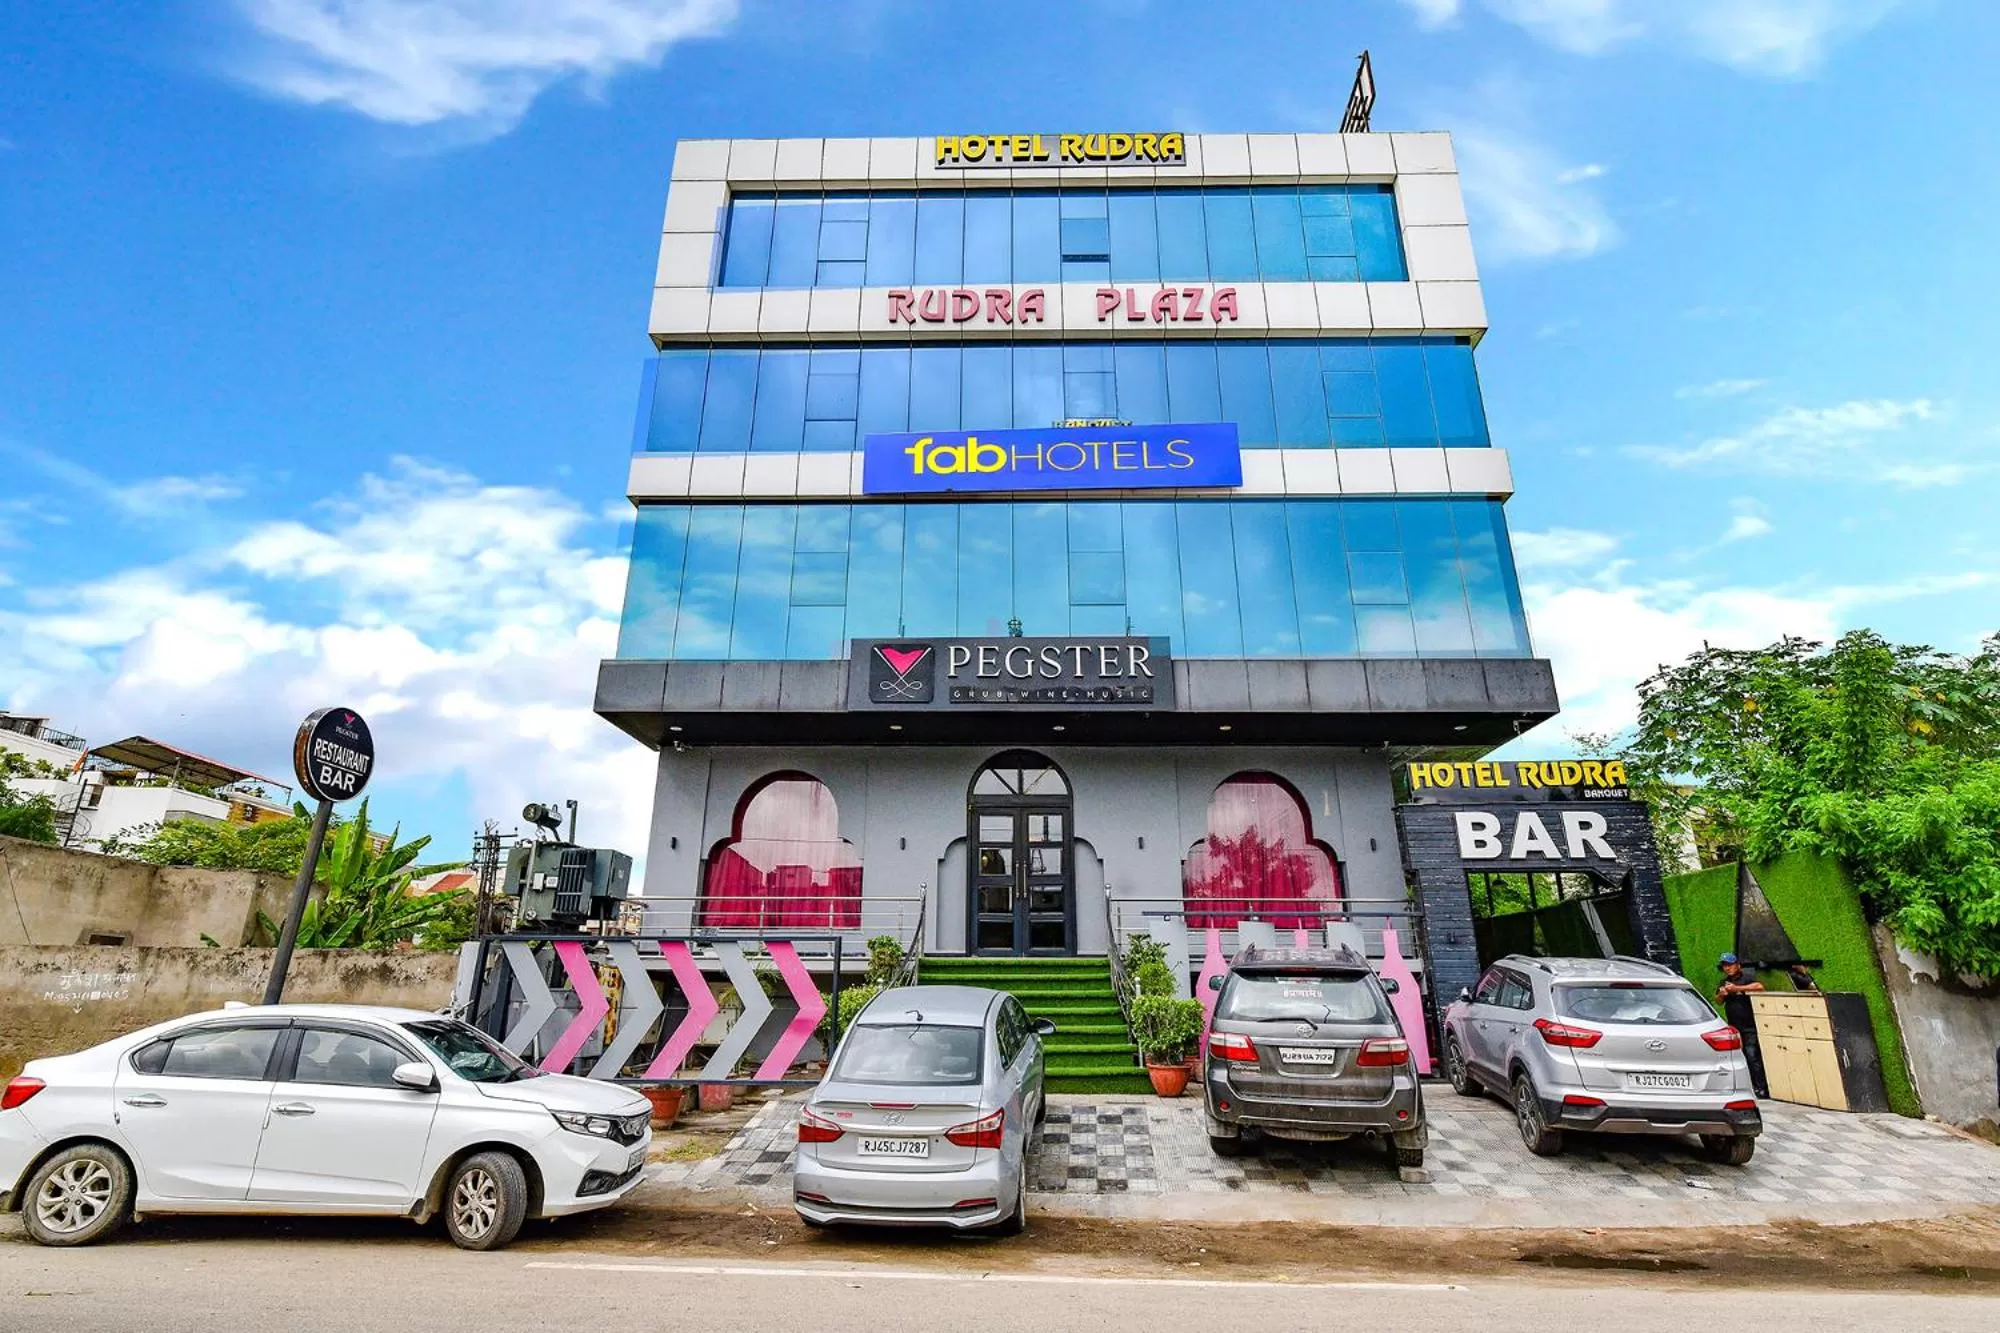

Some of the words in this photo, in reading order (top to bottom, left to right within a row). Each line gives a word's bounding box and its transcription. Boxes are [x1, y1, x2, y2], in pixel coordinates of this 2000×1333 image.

[936, 134, 1049, 165] HOTEL
[1059, 133, 1184, 163] RUDRA
[888, 289, 1045, 324] RUDRA
[1096, 288, 1238, 323] PLAZA
[948, 645, 1154, 678] PEGSTER
[953, 690, 1003, 699] GRUB
[1021, 690, 1069, 699] WINE
[1087, 690, 1149, 699] MUSIC
[313, 738, 370, 774] RESTAURANT
[319, 764, 356, 793] BAR
[1410, 762, 1510, 790] HOTEL
[1516, 760, 1628, 788] RUDRA
[1583, 788, 1629, 798] BANQUET
[1454, 811, 1617, 860] BAR
[864, 1140, 927, 1154] RJ45CJ7287
